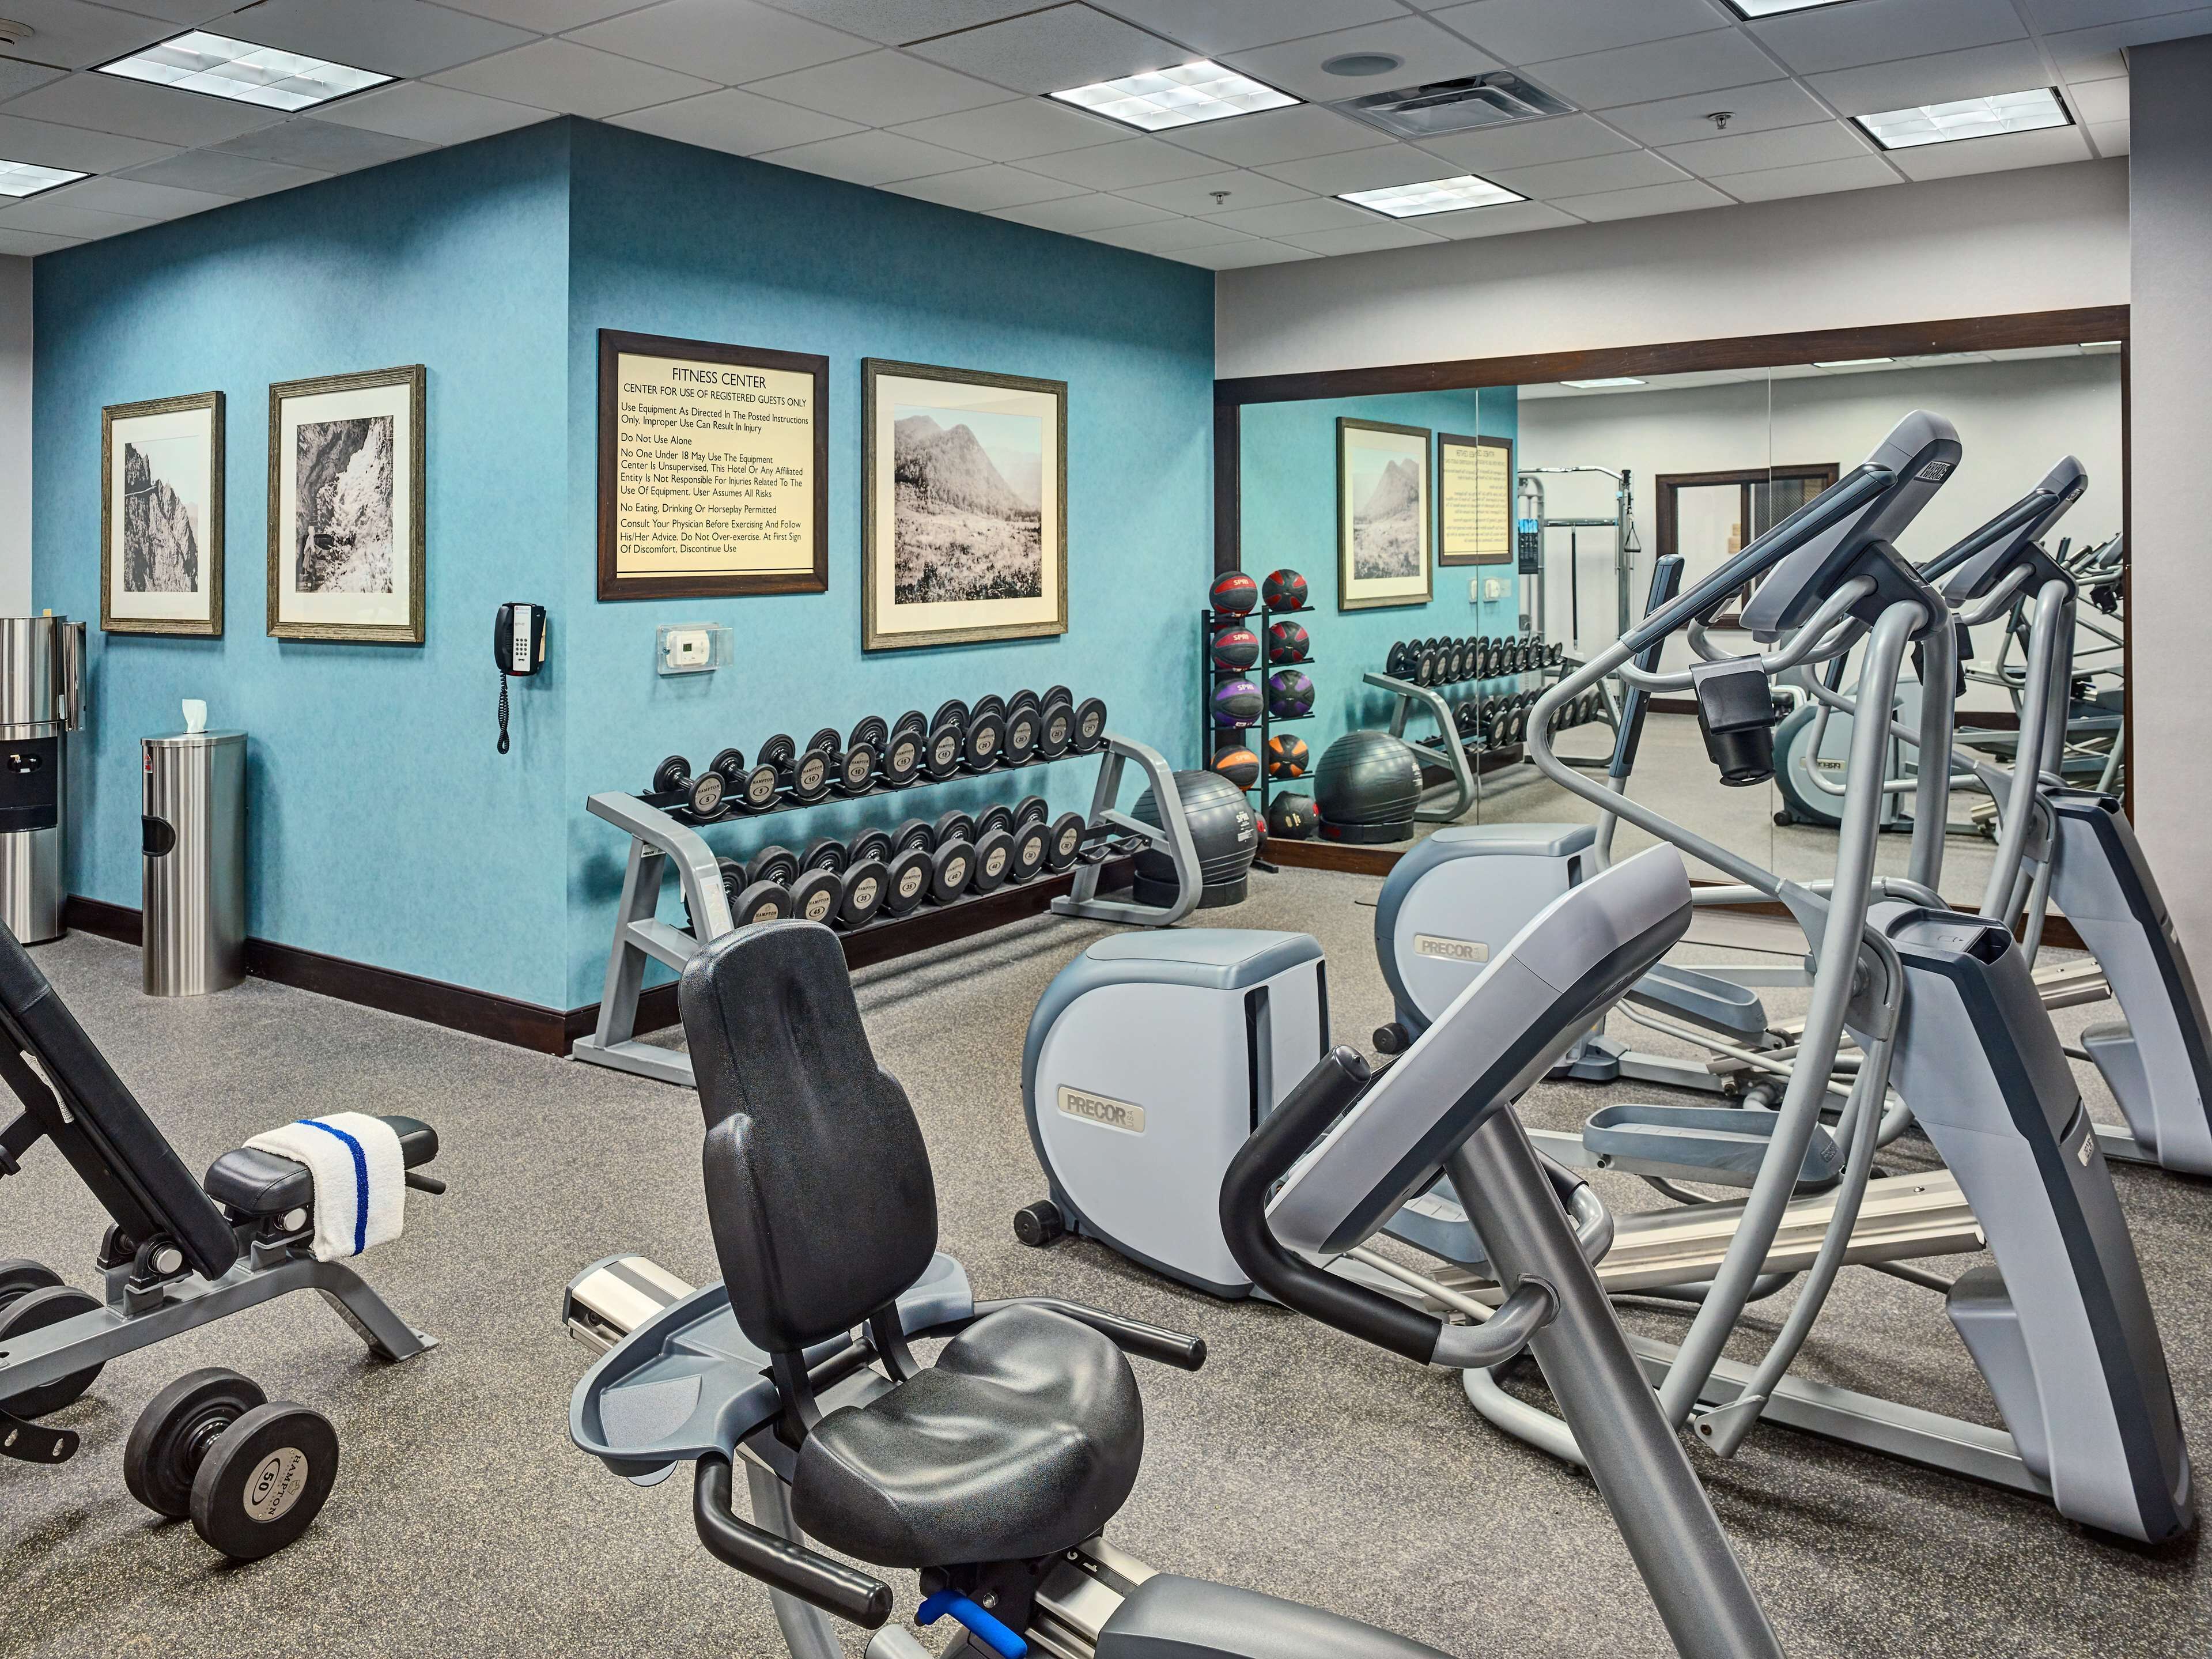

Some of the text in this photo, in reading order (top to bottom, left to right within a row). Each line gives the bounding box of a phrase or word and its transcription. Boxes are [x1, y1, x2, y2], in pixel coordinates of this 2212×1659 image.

[672, 368, 766, 389] FITNESS CENTER
[623, 383, 807, 407] CENTER FOR USE OF REGISTERED GUESTS ONLY
[621, 402, 808, 425] Use Equipment As Directed In The Posted Instructions
[621, 414, 762, 434] Only. Improper Use Can Result In Injury
[621, 432, 692, 445] Do Not Use Alone
[621, 448, 773, 465] No One Under 18 May Use The Equipment
[621, 459, 803, 477] Center Is Unsupervised, This Hotel Or Any Affiliated
[621, 472, 802, 487] Entity Is Not Responsible For Injuries Related To The
[621, 485, 772, 498] Use Of Equipment. User Assumes All Risks
[621, 502, 776, 516] No Eating, Drinking Or Horseplay Permitted
[621, 519, 801, 531] Consult Your Physician Before Exercising And Follow
[620, 532, 649, 541] His/Her
[652, 532, 678, 541] Advice.
[681, 532, 693, 541] Do
[695, 532, 709, 541] Not
[763, 532, 771, 541] At
[773, 532, 787, 541] First
[789, 532, 801, 543] Sign
[620, 544, 736, 553] Of Discomfort, Discontinue Use
[803, 765, 822, 773] HAMPTON
[697, 784, 720, 794] HAMPTON
[1422, 940, 1473, 958] PRECOR
[1067, 1094, 1126, 1125] PRECOR
[258, 1472, 275, 1491] 50
[268, 1455, 301, 1516] HAMPTON
[1083, 1562, 1098, 1573] 1
